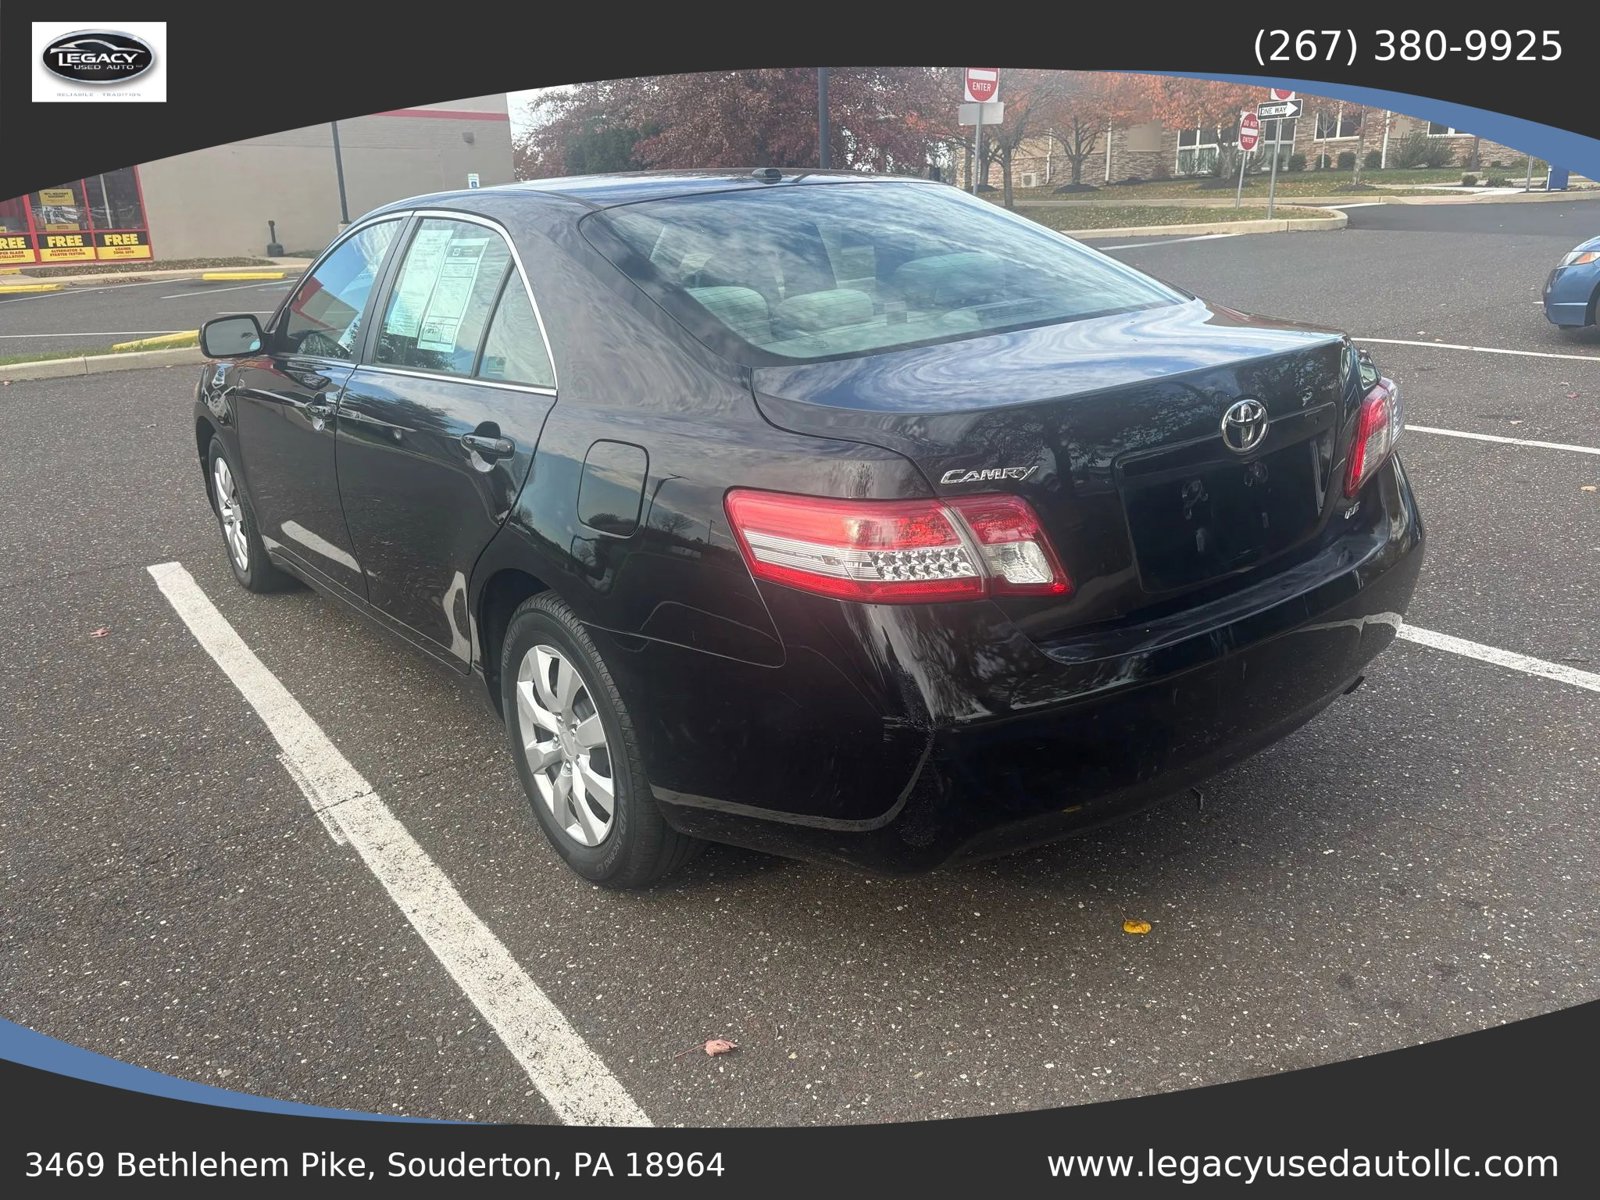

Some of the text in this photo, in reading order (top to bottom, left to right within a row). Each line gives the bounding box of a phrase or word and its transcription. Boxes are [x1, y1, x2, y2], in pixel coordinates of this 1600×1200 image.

[972, 82, 992, 92] ENTER
[1260, 106, 1287, 115] ONE WAY
[1242, 136, 1254, 144] ENTER
[47, 235, 83, 247] FREE
[104, 234, 139, 246] FREE
[940, 465, 1039, 485] CAMRY
